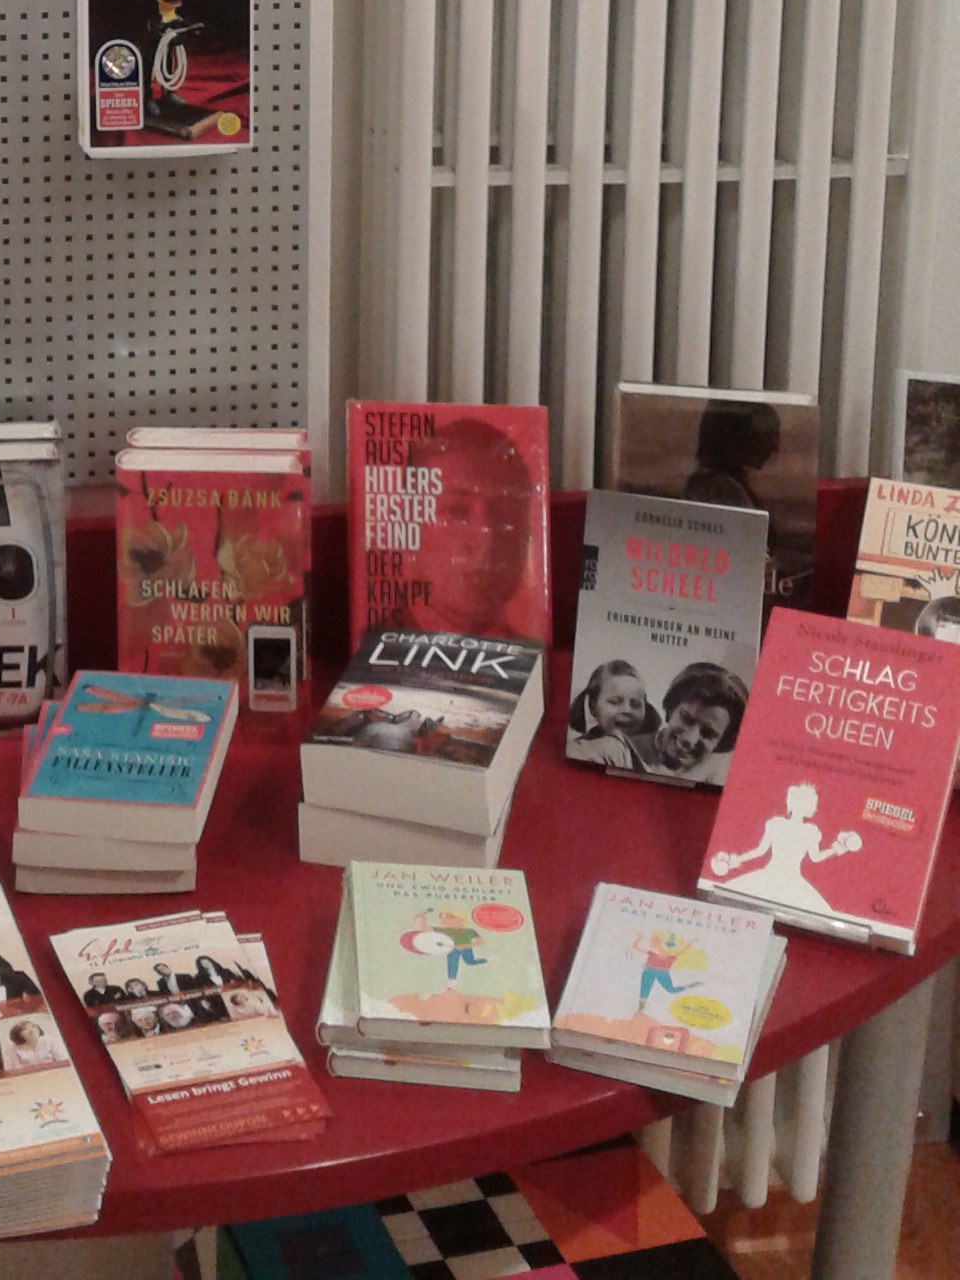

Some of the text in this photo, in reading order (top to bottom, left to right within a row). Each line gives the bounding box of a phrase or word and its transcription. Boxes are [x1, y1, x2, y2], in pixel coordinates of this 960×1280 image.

[365, 412, 435, 438] STEFAN
[365, 440, 416, 466] AUST
[365, 464, 443, 496] HITLERS
[146, 487, 221, 507] ZSUZSA
[365, 493, 437, 524] ERSTER
[877, 485, 935, 508] LINDA
[635, 511, 683, 529] CORNELIA
[365, 520, 421, 552] FEIND
[367, 550, 403, 577] DER
[626, 536, 729, 575] MILDRED
[141, 579, 236, 599] SCHLAFEN
[367, 580, 432, 607] KAMPF
[630, 569, 717, 602] SCHEEL
[171, 602, 291, 623] WERDEN WIR
[151, 623, 218, 645] SPÄTER
[607, 611, 736, 642] ERINNERUNGEN AN MEINE
[380, 632, 523, 655] CHARLOTTE
[650, 633, 689, 648] MUTTER
[368, 642, 516, 680] LINK
[809, 651, 918, 692] SCHLAG
[777, 675, 937, 728] FERTIGKEITS
[805, 713, 894, 750] QUEEN
[865, 797, 915, 822] SPIEGEL
[373, 870, 513, 886] JAN WEILER
[609, 894, 757, 929] JAN WEILER
[148, 1069, 292, 1105] Lesen bringt Gewinn
